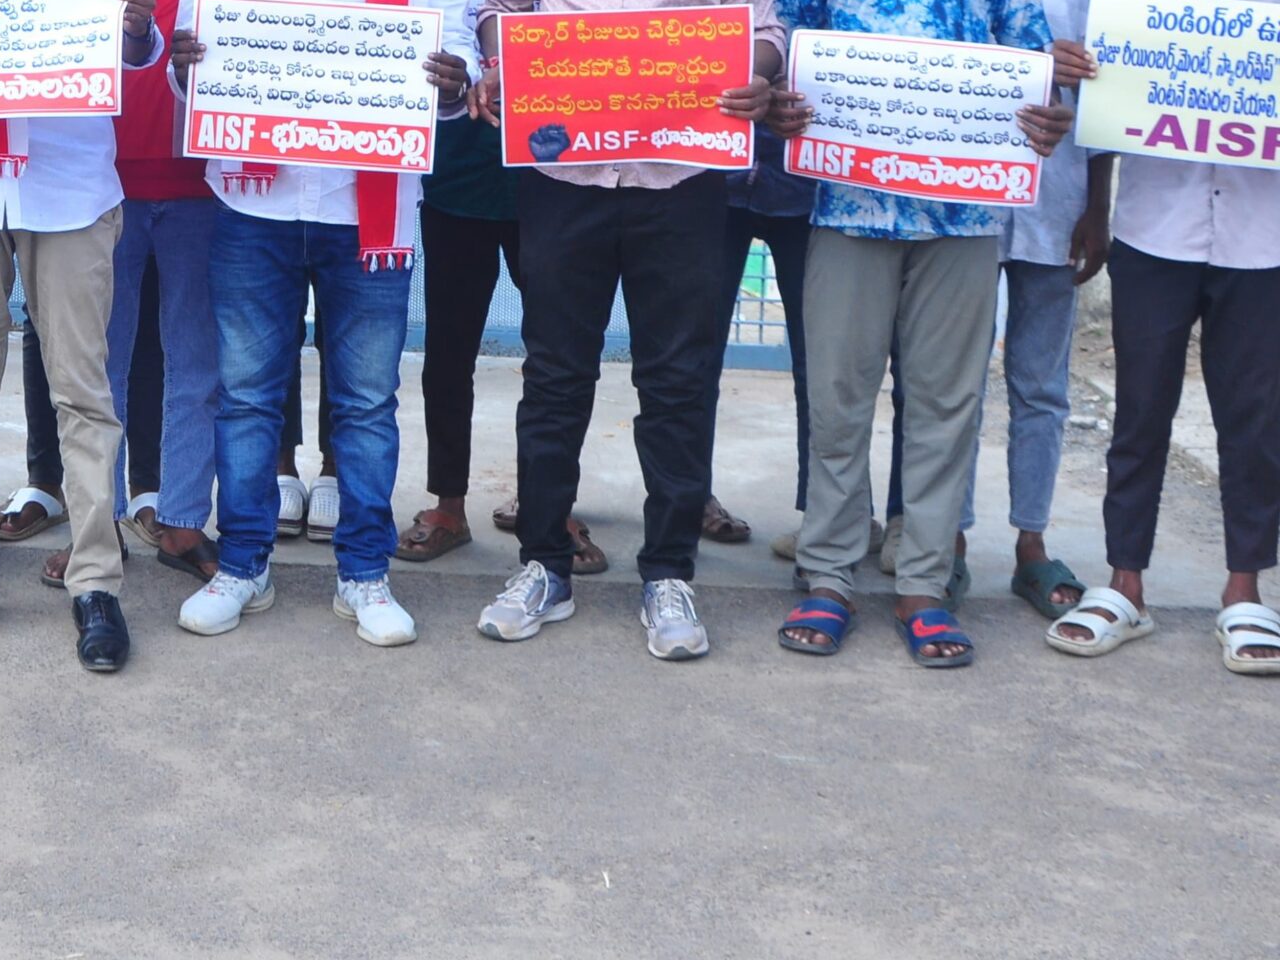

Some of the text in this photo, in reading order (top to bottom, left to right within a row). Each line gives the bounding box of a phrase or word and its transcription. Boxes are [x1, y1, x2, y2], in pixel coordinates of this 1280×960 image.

[576, 19, 640, 43] ఫీజులు
[646, 17, 744, 46] చెల్లింపులు
[217, 37, 416, 60] బకాయిలు విడుదల చేయండి
[286, 62, 325, 78] కోసం
[197, 81, 262, 105] పడుతున్న
[814, 72, 1024, 99] బకాయిలు విడుదల చేయండి
[511, 94, 602, 115] చదువులు
[886, 99, 928, 116] కోసం
[198, 114, 255, 150] AISF
[798, 140, 856, 176] AISF
